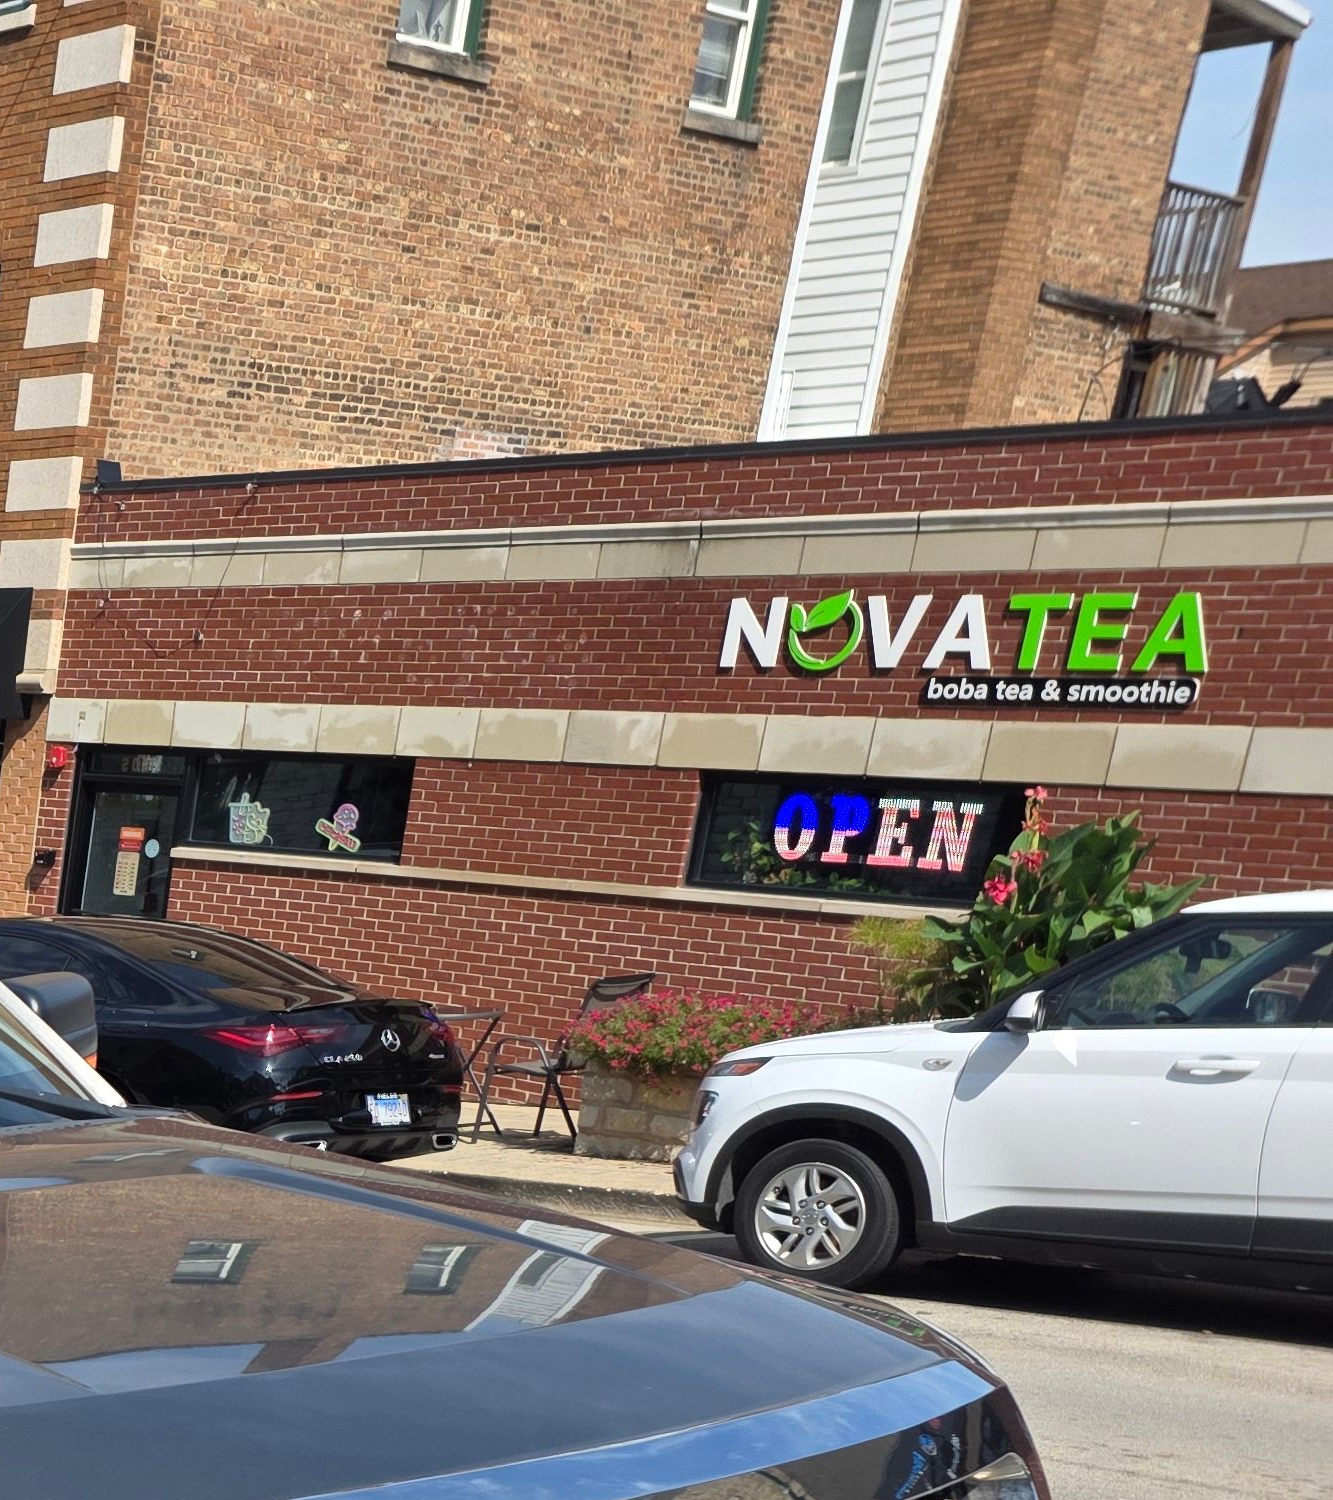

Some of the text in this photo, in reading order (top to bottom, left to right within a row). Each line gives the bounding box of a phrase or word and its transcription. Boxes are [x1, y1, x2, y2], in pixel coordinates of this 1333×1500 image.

[1009, 592, 1209, 674] TEA
[927, 678, 1192, 705] boba tea & smoothie
[773, 791, 985, 874] OPEN
